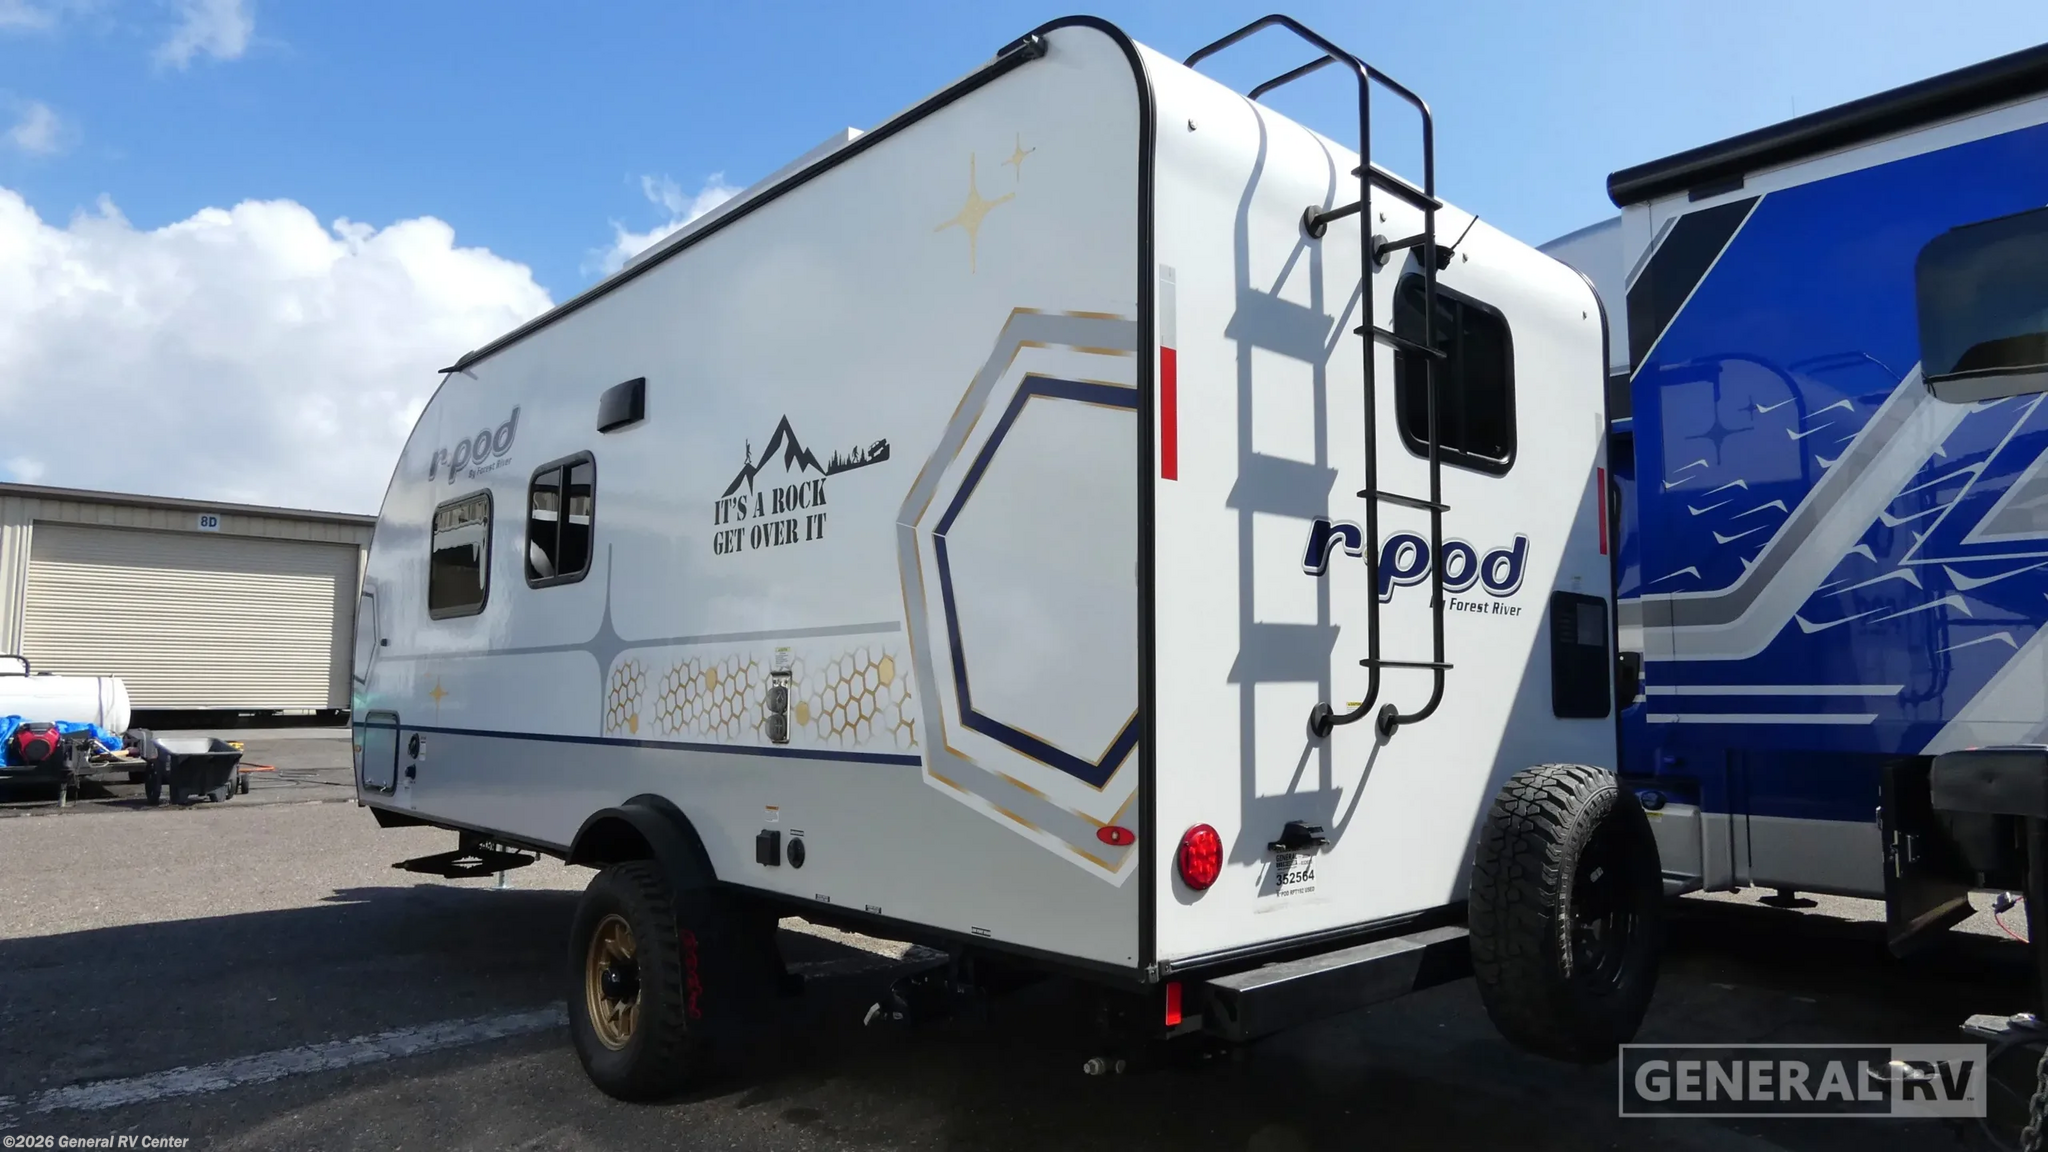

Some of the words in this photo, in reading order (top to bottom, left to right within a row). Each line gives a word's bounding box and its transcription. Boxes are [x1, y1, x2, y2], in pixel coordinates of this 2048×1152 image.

[477, 462, 496, 476] Forest
[714, 495, 748, 526] IT'S
[752, 491, 765, 519] A
[771, 477, 827, 515] ROCK
[201, 515, 217, 527] 8D
[713, 527, 745, 556] GET
[750, 518, 799, 550] OVER
[805, 512, 827, 541] IT
[1449, 597, 1489, 614] Forest
[1492, 601, 1523, 617] River
[1276, 869, 1314, 886] 352564
